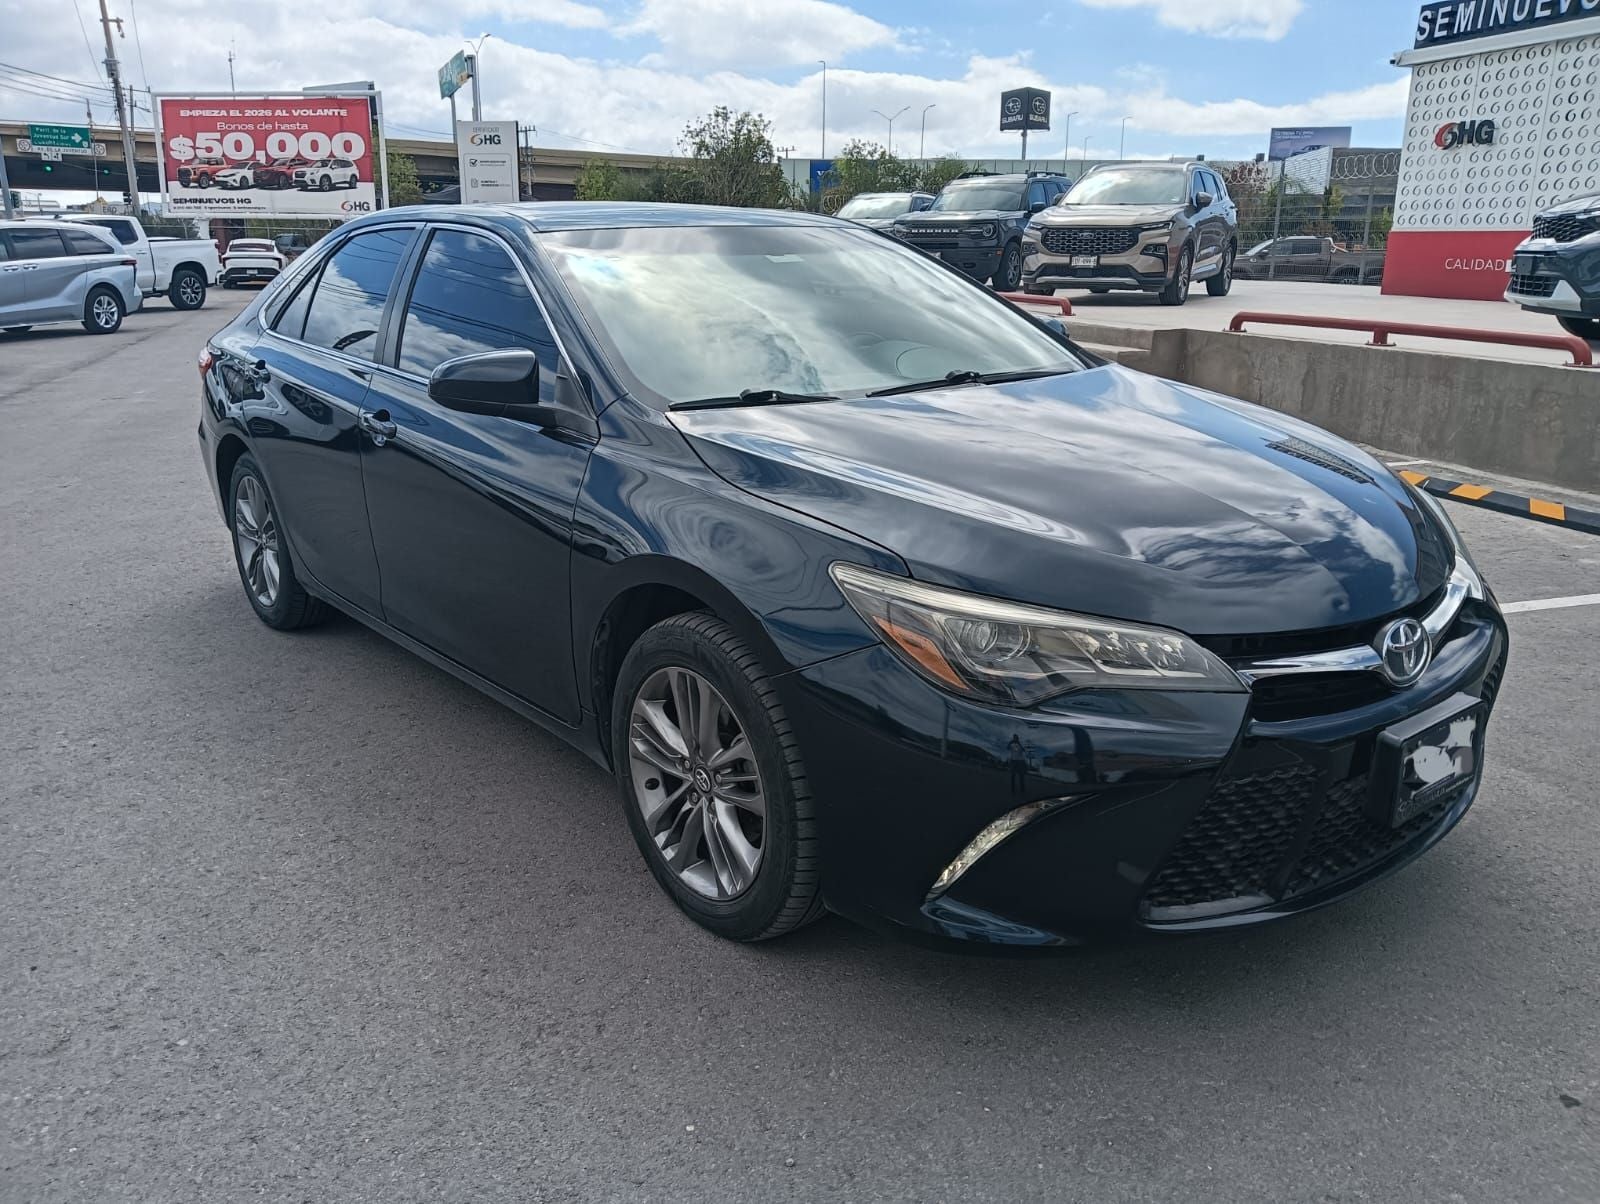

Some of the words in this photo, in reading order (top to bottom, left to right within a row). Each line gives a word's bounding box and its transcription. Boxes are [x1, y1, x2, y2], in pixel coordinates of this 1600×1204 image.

[180, 109, 227, 117] EMPIEZA
[229, 109, 243, 117] EL
[244, 109, 272, 117] 2026
[274, 109, 289, 117] AL
[291, 109, 348, 117] VOLANTE
[216, 122, 255, 131] Bonos
[256, 122, 272, 131] de
[274, 122, 309, 131] hasta
[1456, 119, 1496, 145] HG
[483, 134, 502, 145] HG
[169, 132, 365, 165] $50,000
[353, 201, 371, 212] HG
[1444, 258, 1505, 272] CALIDAD
